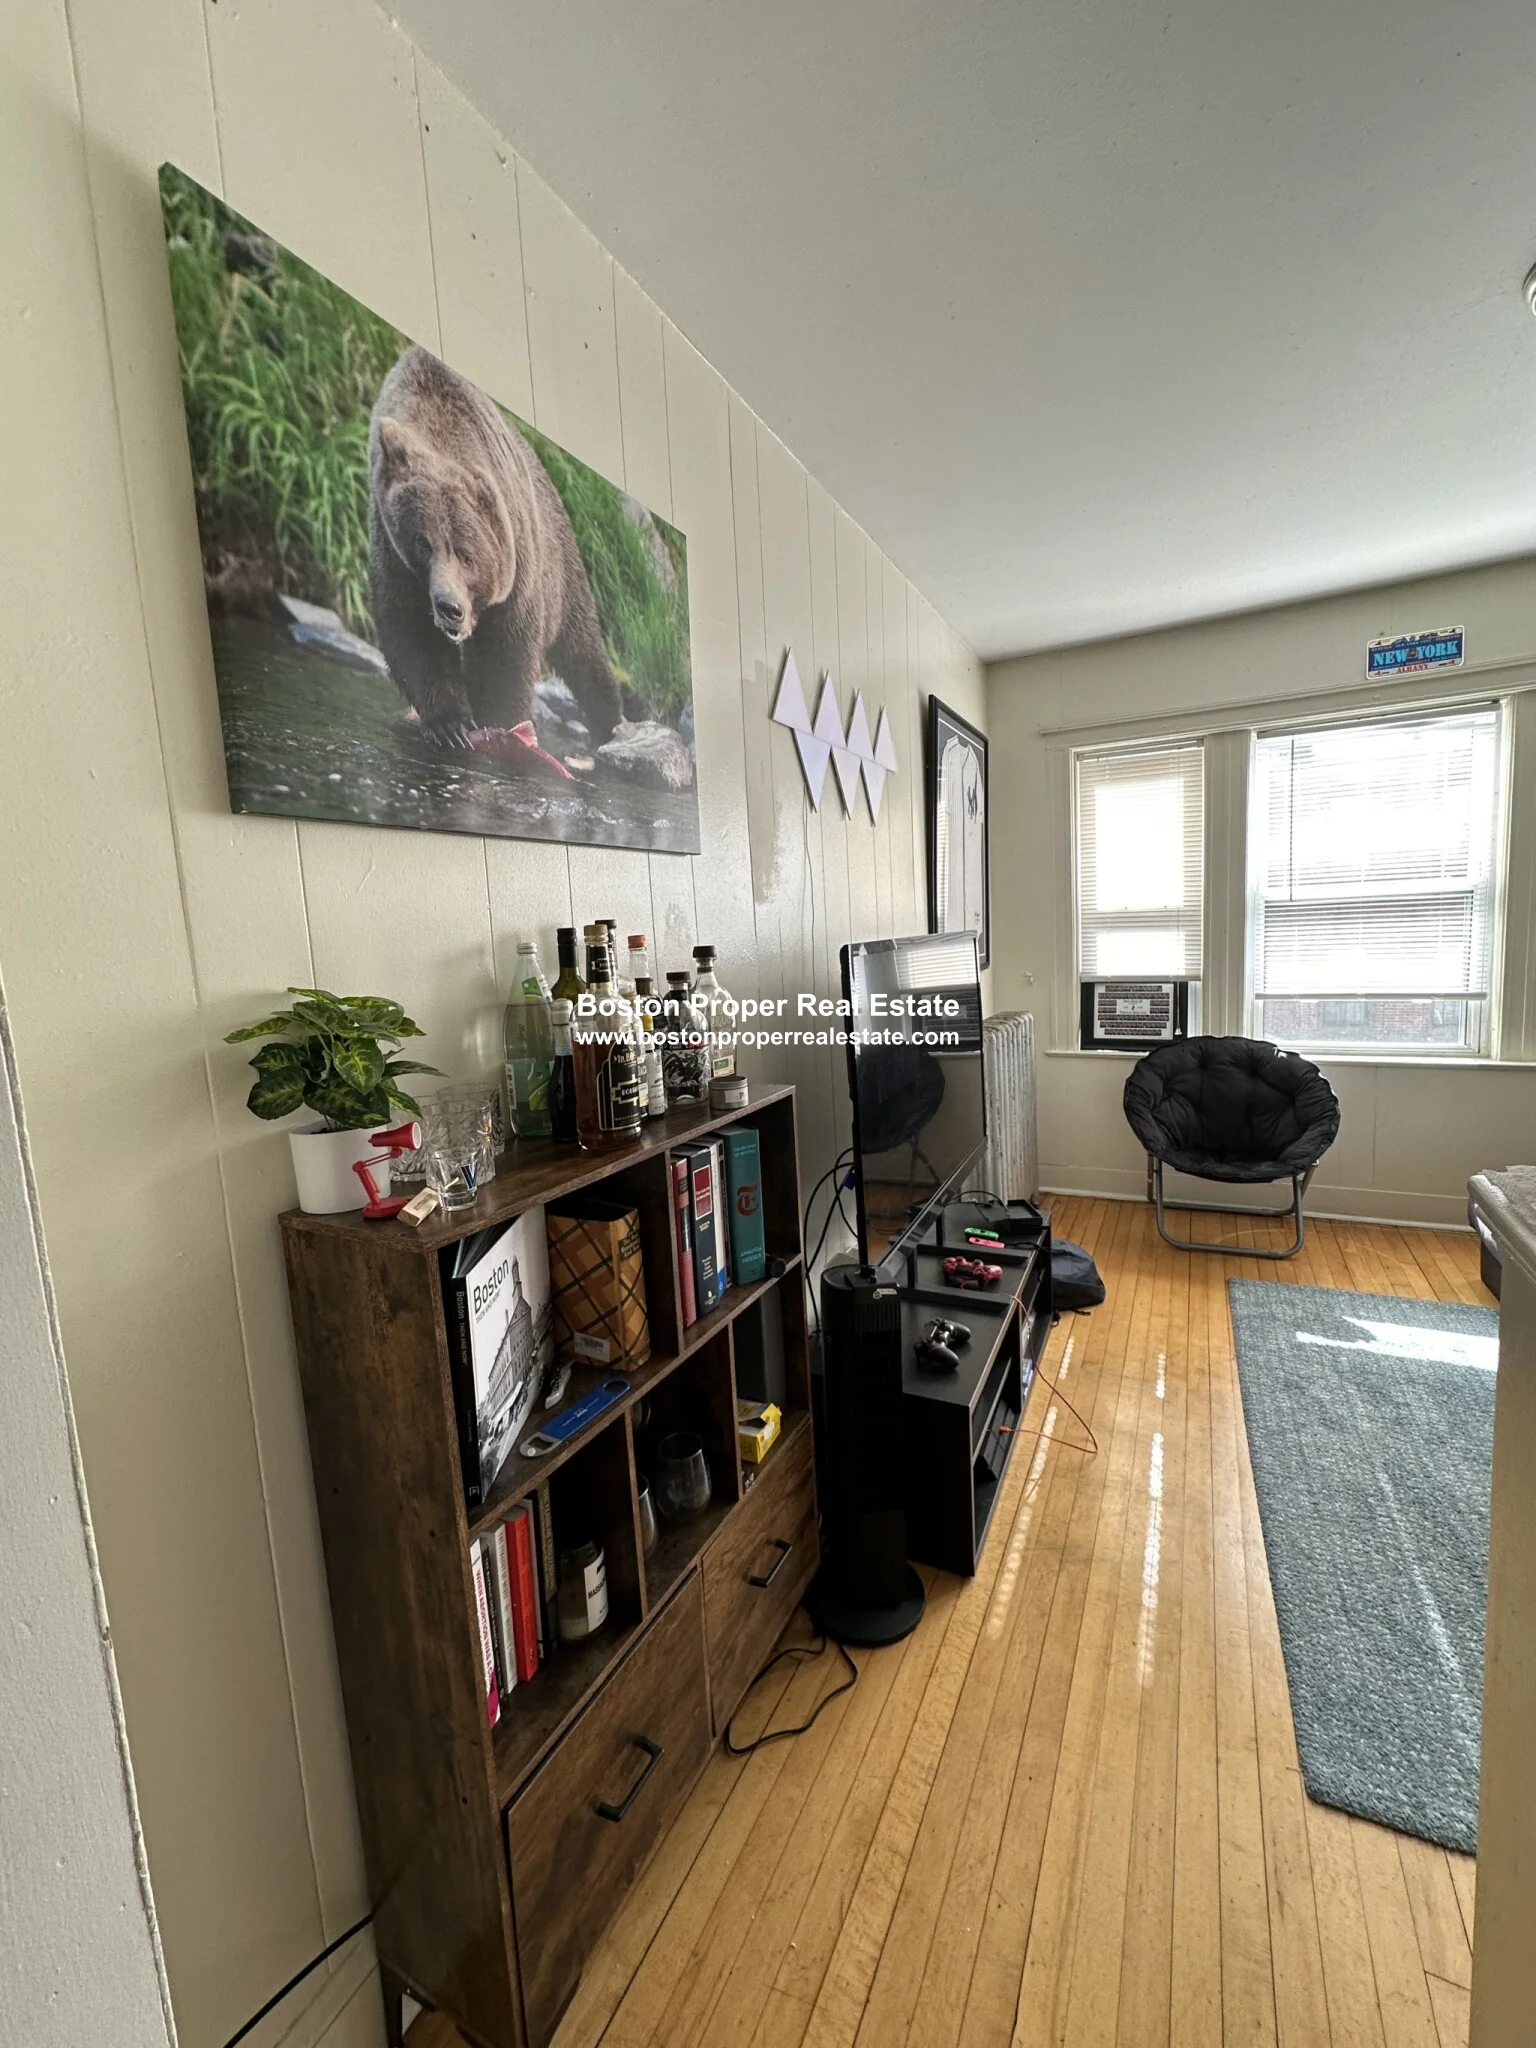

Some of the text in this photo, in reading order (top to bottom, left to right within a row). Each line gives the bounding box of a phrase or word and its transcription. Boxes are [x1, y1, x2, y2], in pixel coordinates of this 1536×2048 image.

[1373, 640, 1459, 667] NEW YORK
[1396, 663, 1429, 674] ALBANY
[473, 1259, 509, 1314] Boston
[456, 1291, 465, 1319] Boston
[475, 1570, 484, 1598] WHEN
[479, 1597, 488, 1640] ABORTION
